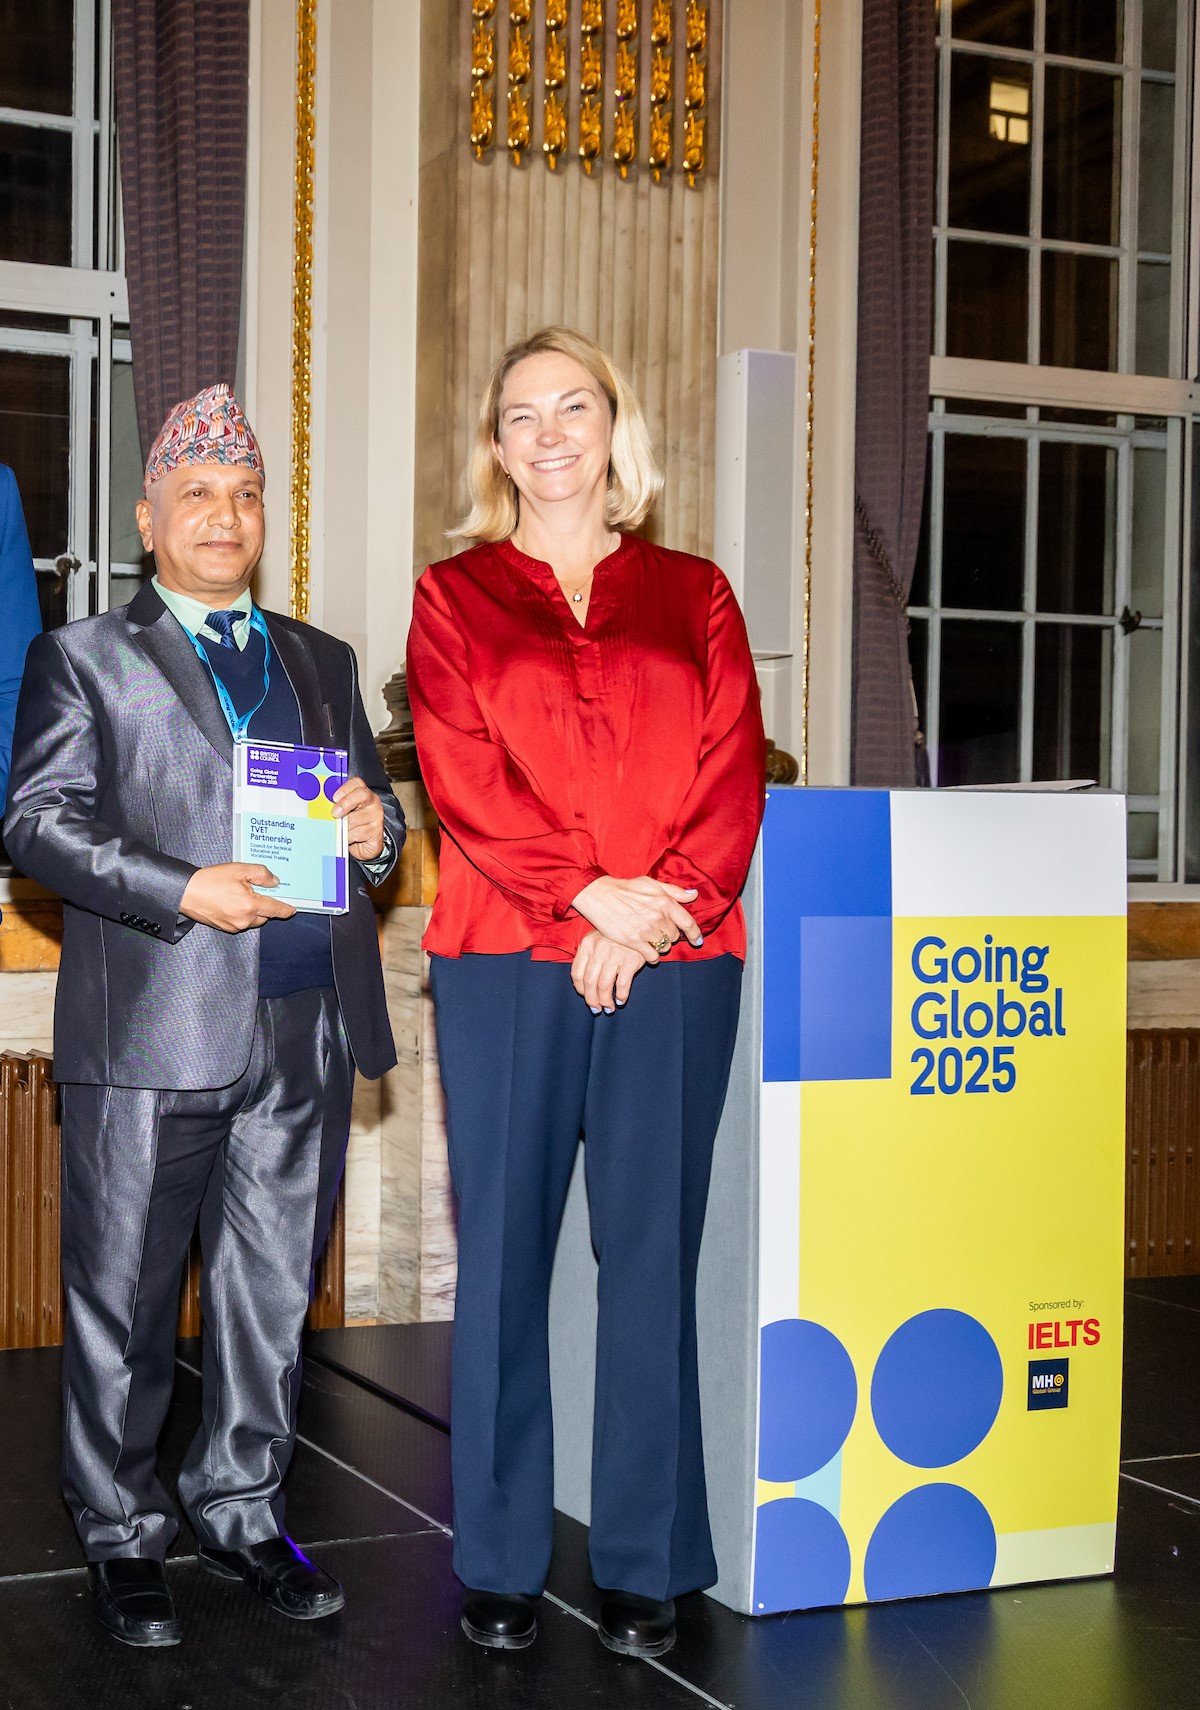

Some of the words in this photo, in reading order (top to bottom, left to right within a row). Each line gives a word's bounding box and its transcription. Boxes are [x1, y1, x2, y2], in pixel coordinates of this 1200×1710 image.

[250, 817, 296, 830] Outstanding
[250, 825, 269, 834] TVET
[250, 832, 293, 845] Partnership
[911, 933, 1050, 994] Going
[910, 987, 1067, 1040] Global
[910, 1045, 1016, 1096] 2025
[1028, 1299, 1071, 1312] Sponsored
[1028, 1318, 1101, 1350] IELTS
